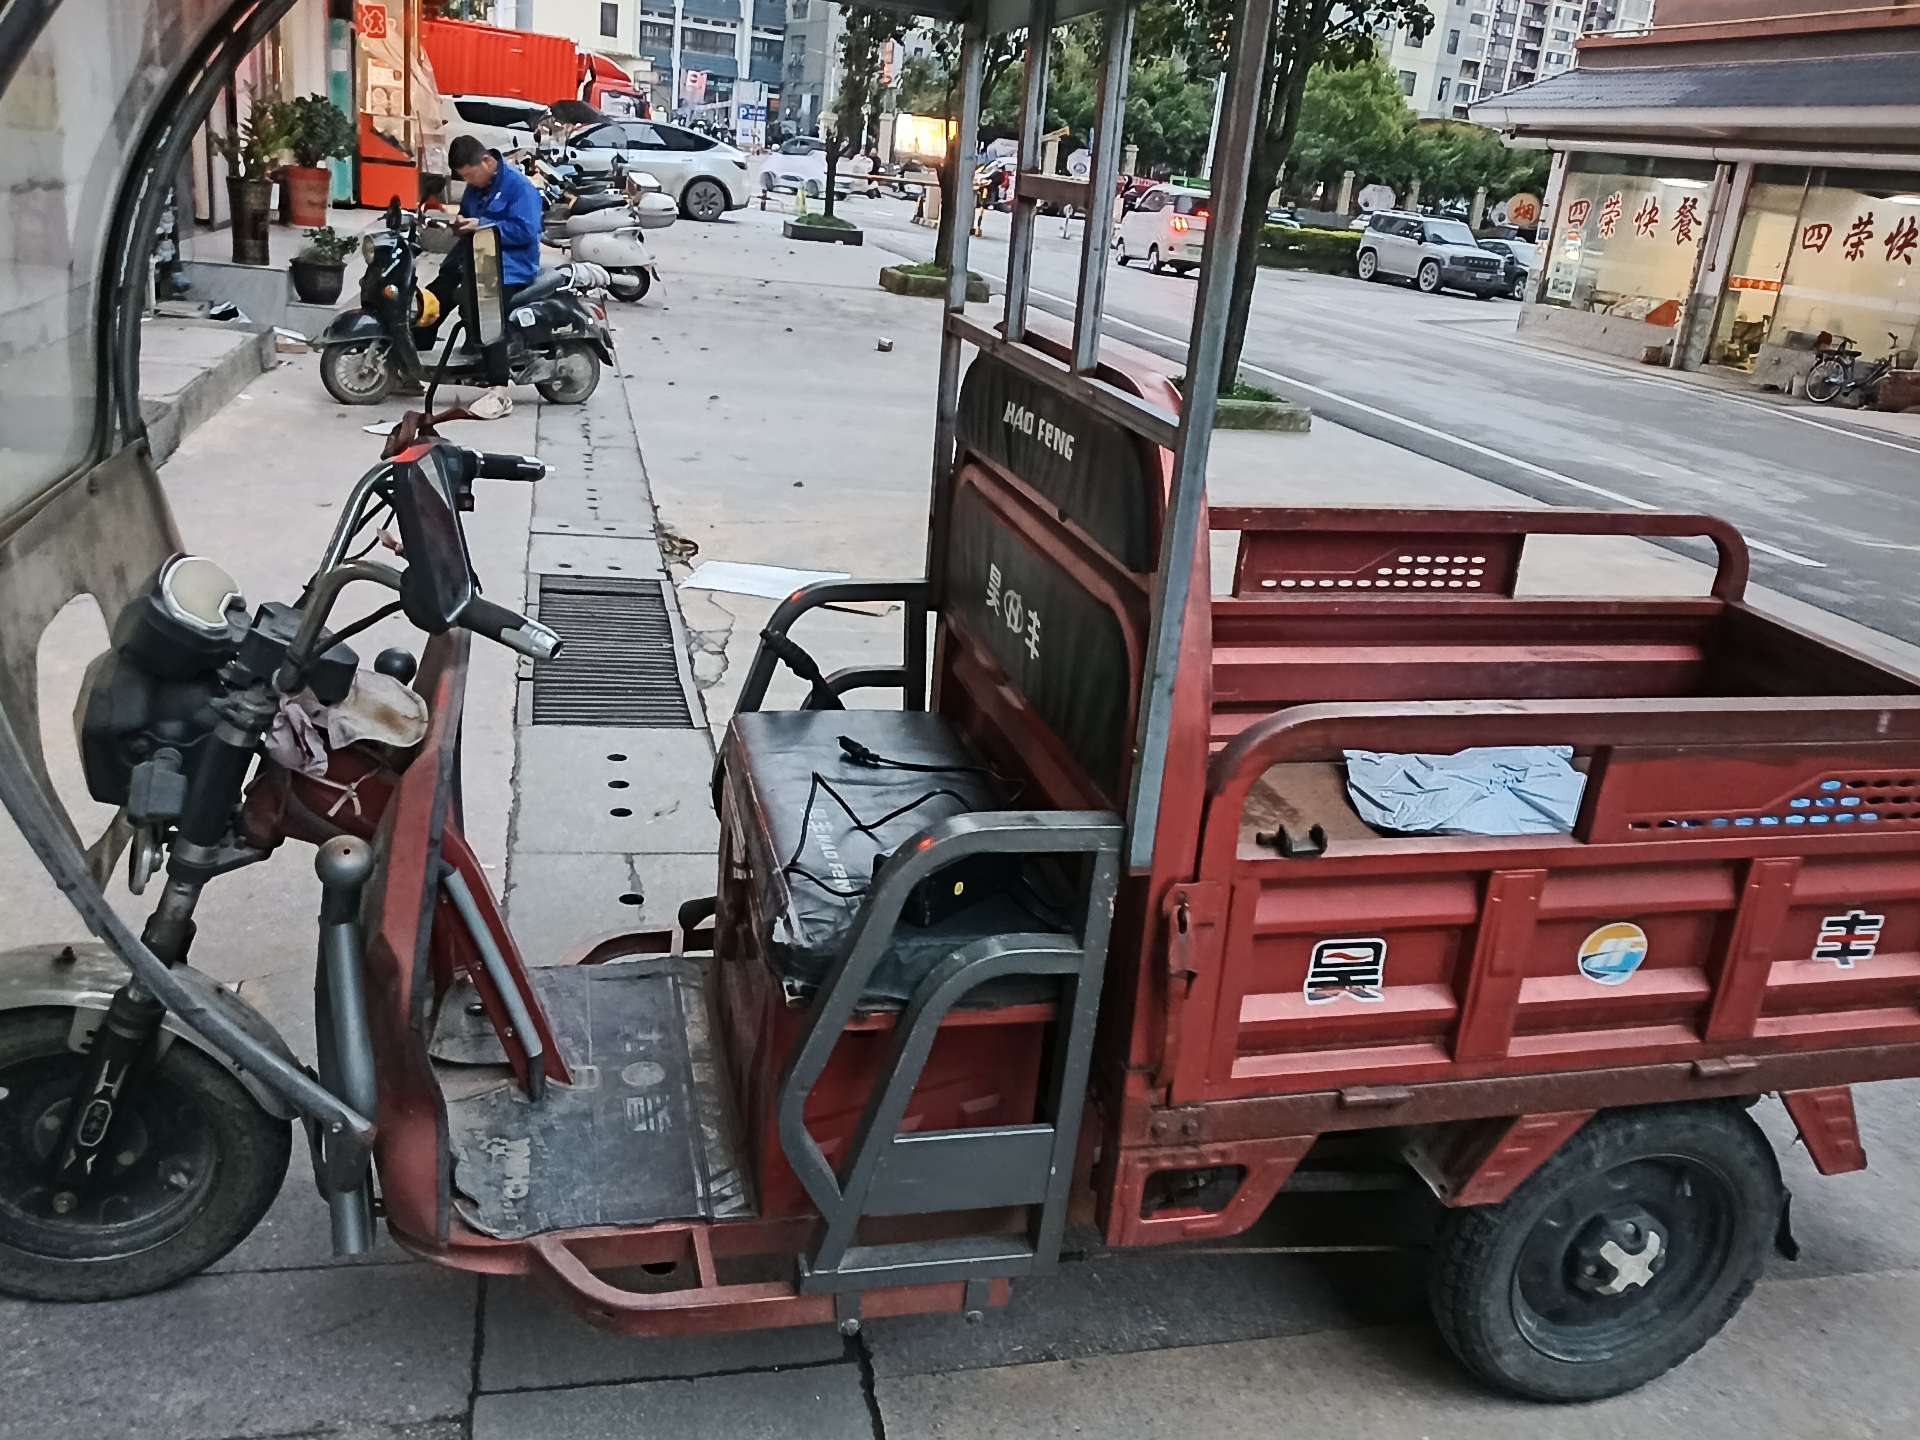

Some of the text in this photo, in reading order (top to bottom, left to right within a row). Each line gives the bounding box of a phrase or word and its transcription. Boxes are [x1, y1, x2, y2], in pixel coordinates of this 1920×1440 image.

[1512, 198, 1534, 222] 烟
[1566, 191, 1702, 245] 四荣快餐
[1802, 211, 1919, 266] 四荣快
[1003, 401, 1035, 435] HAO
